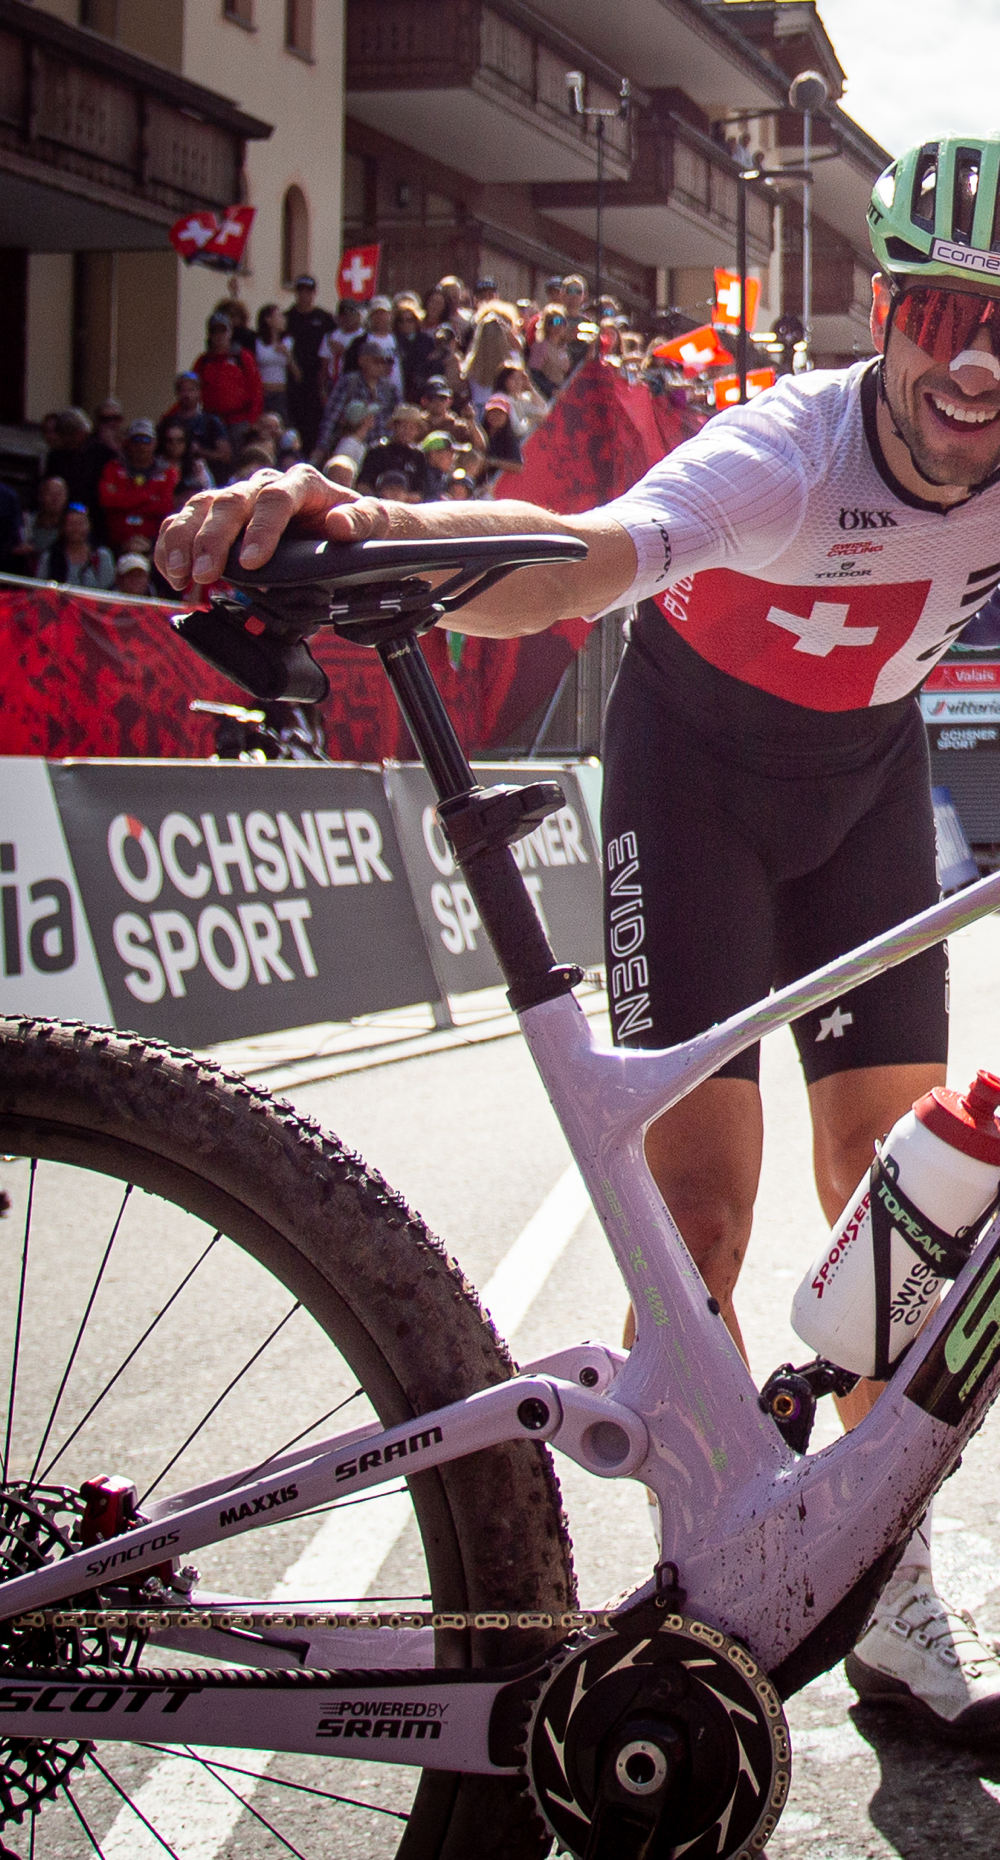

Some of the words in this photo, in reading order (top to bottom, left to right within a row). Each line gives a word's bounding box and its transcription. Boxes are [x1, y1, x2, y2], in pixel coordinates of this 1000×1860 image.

[815, 570, 872, 578] TUDOR
[955, 670, 995, 682] Valais
[107, 809, 394, 903] OCHSNER
[112, 898, 319, 1004] SPORT
[608, 831, 653, 1040] EVIDEN
[877, 1180, 947, 1263] TOPEAK
[335, 1426, 443, 1483] SRAM
[219, 1484, 299, 1528] MAXXIS
[85, 1529, 180, 1578] syncros
[0, 1686, 204, 1713] SCOTT
[315, 1719, 442, 1739] SRAM
